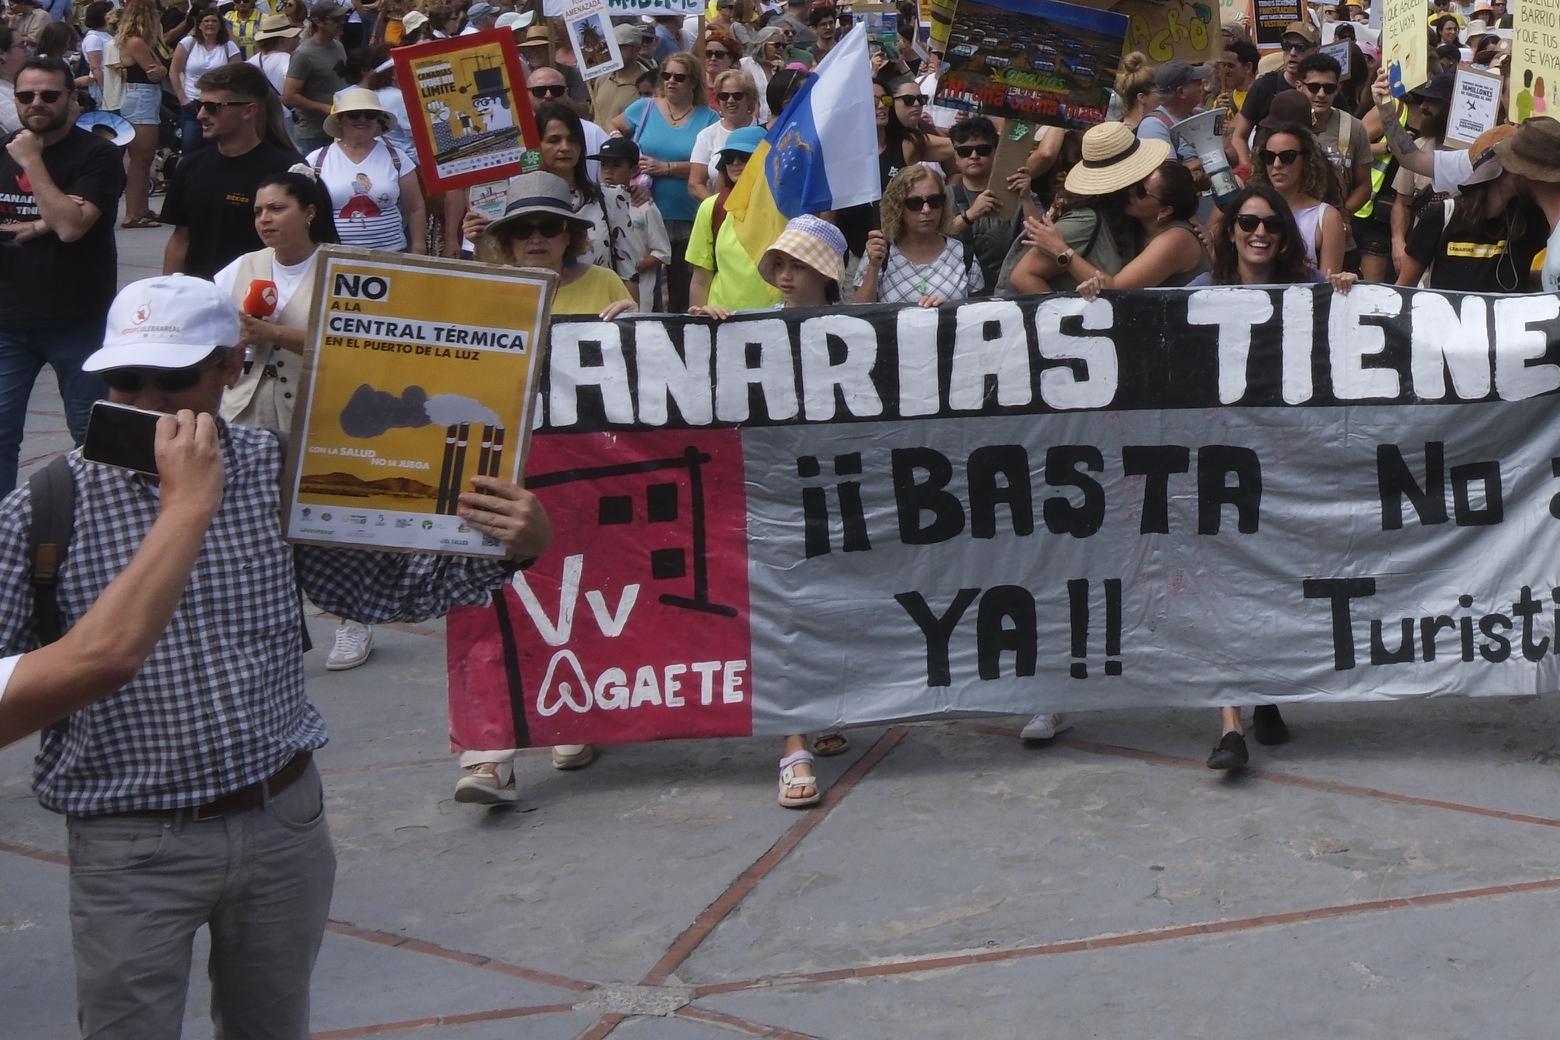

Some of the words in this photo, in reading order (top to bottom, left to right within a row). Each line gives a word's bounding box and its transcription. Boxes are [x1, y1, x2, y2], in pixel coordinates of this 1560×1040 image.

[566, 0, 602, 17] AMENAZADA
[1521, 6, 1556, 28] BARRIO
[1123, 8, 1209, 62] AGRO
[1515, 27, 1521, 41] Y
[1522, 29, 1538, 45] QUE
[1542, 33, 1557, 49] TUS
[1524, 48, 1537, 64] SE
[334, 274, 388, 300] NO
[331, 301, 340, 310] A
[345, 302, 361, 312] LA
[329, 316, 425, 340] CENTRAL
[433, 325, 524, 351] TÉRMICA
[325, 336, 342, 347] EN
[346, 338, 359, 348] EL
[363, 340, 412, 354] PUERTO
[416, 345, 431, 356] DE
[435, 348, 451, 358] LA
[455, 350, 480, 361] LUZ
[533, 298, 1119, 428] ANARIAS
[1376, 441, 1504, 531] No
